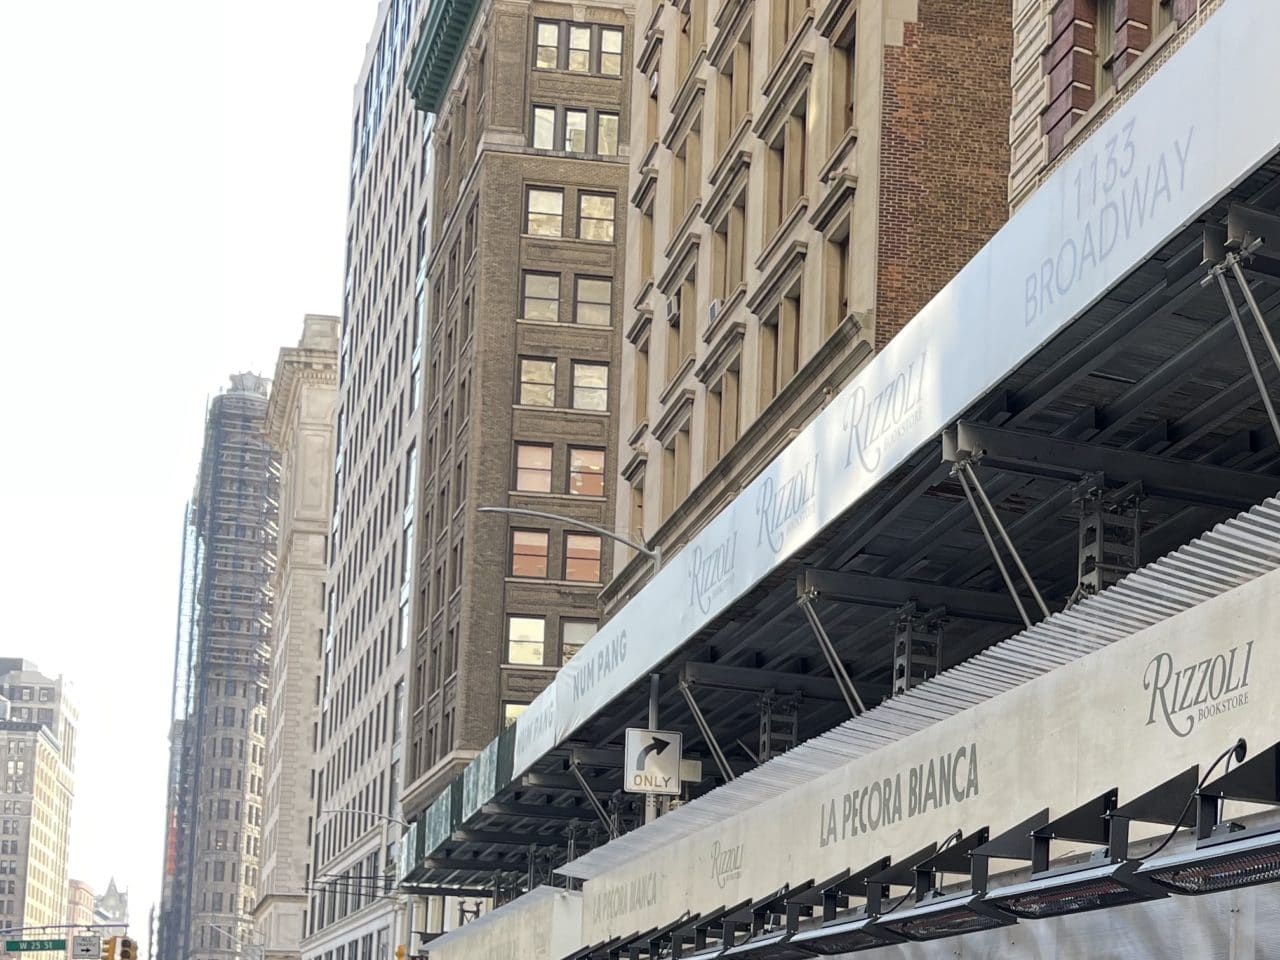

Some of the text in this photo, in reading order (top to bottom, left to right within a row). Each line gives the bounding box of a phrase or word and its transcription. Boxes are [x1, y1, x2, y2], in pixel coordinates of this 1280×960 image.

[1074, 116, 1136, 220] 1133
[1024, 125, 1195, 327] BROADWAY
[843, 349, 927, 473] RIZZOLI
[572, 629, 627, 702] NUM PANG
[1143, 640, 1254, 737] RIZZOLI
[1198, 692, 1249, 722] BOOKSTORE
[633, 773, 672, 788] ONLY
[820, 743, 979, 848] LA PECORA BIANCA
